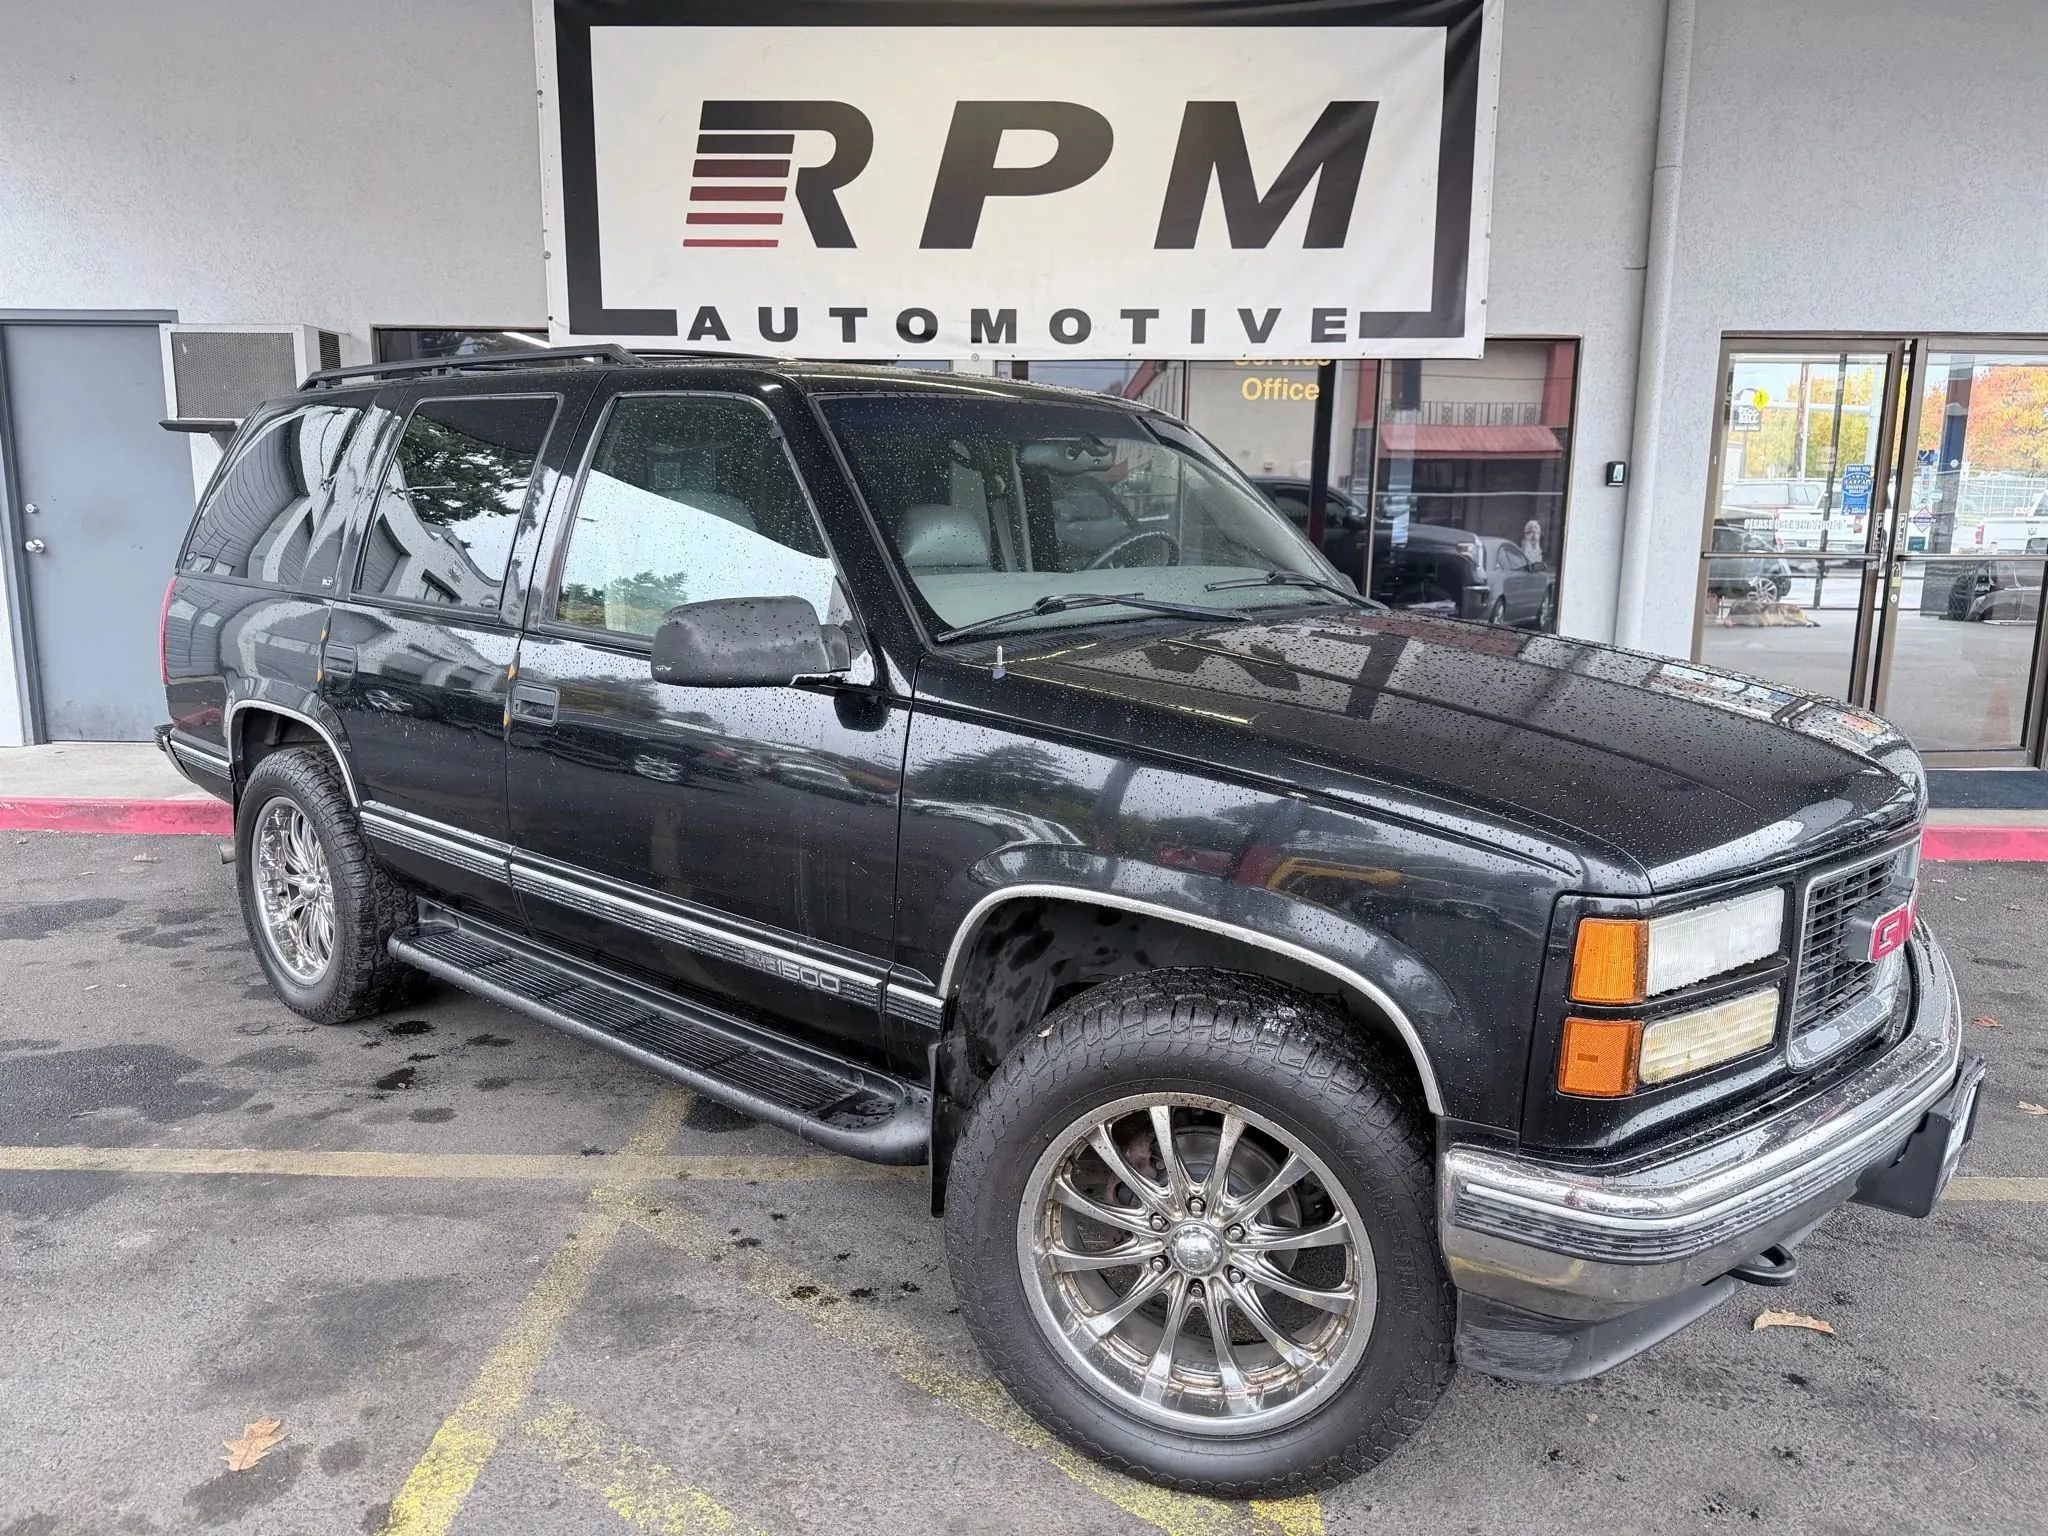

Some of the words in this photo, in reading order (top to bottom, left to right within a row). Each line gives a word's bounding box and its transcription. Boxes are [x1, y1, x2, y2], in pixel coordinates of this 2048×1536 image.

[683, 100, 1379, 249] RPM
[687, 305, 1347, 345] AUTOMOTIVE
[1242, 377, 1320, 401] Office
[776, 959, 840, 993] 1500
